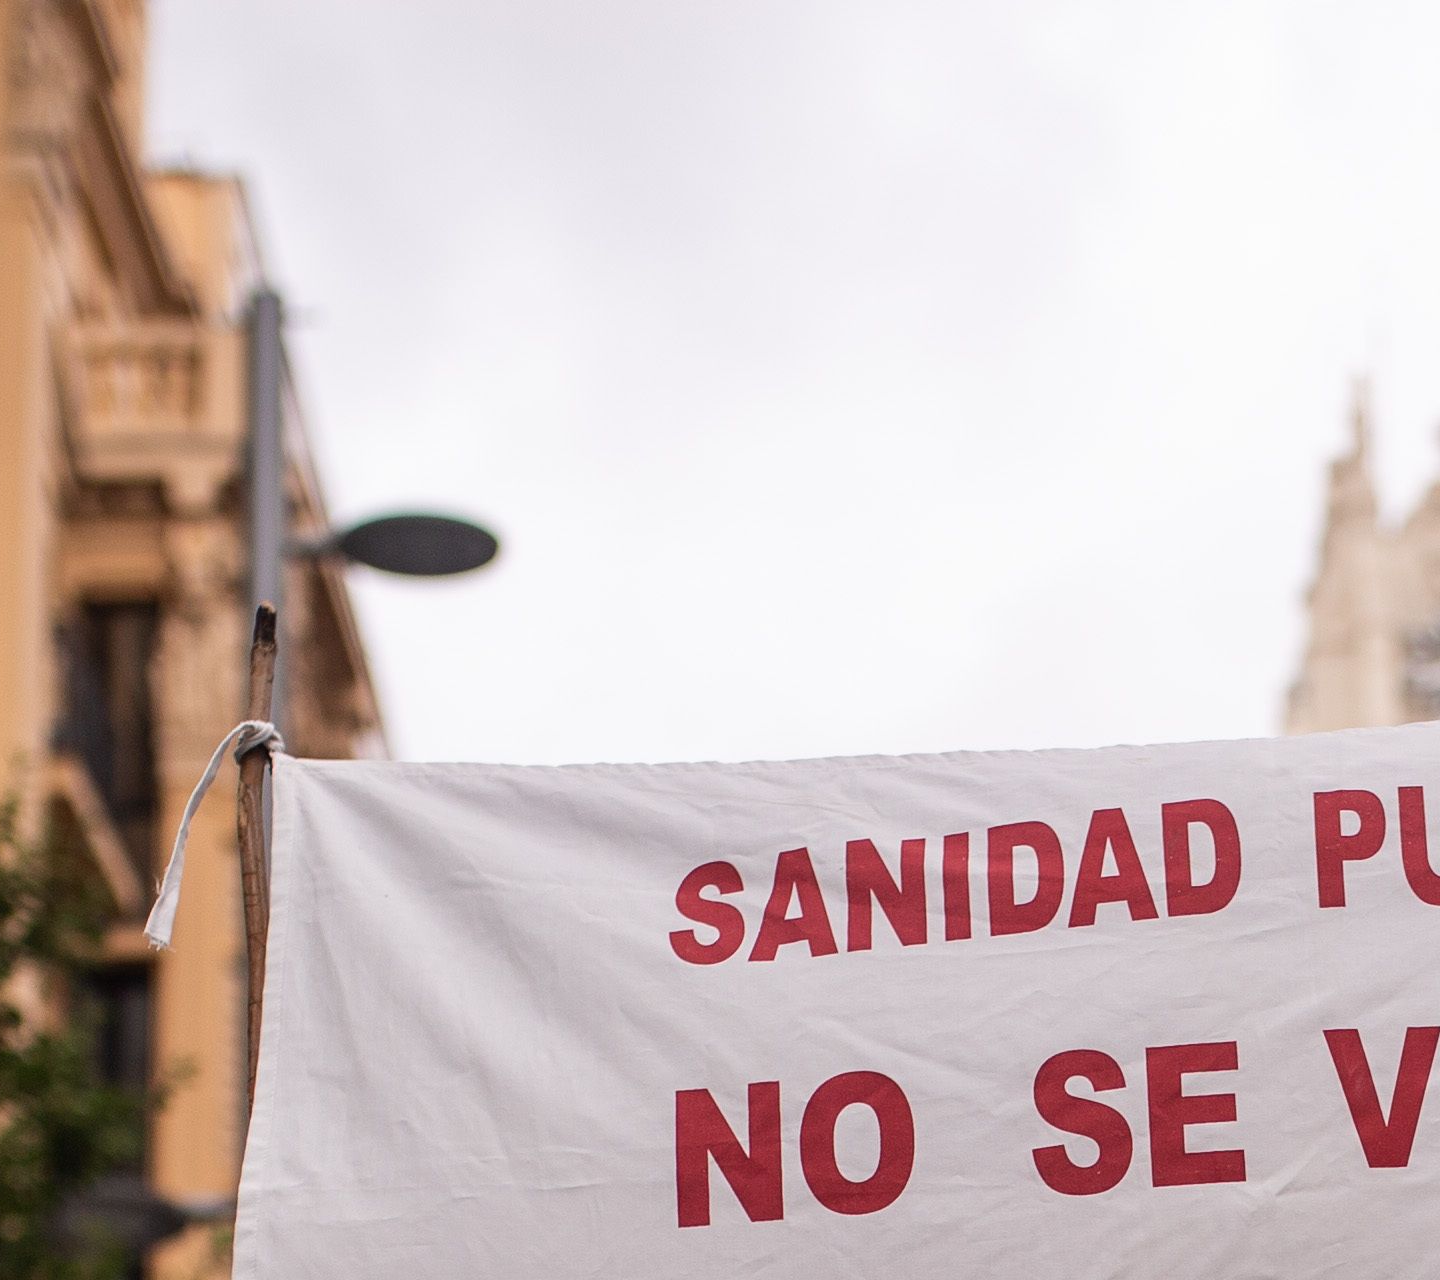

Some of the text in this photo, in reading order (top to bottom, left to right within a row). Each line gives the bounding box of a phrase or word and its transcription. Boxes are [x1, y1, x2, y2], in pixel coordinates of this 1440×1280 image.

[669, 798, 1241, 965] SANIDAD
[675, 1070, 915, 1228] NO
[1032, 1039, 1247, 1196] SE
